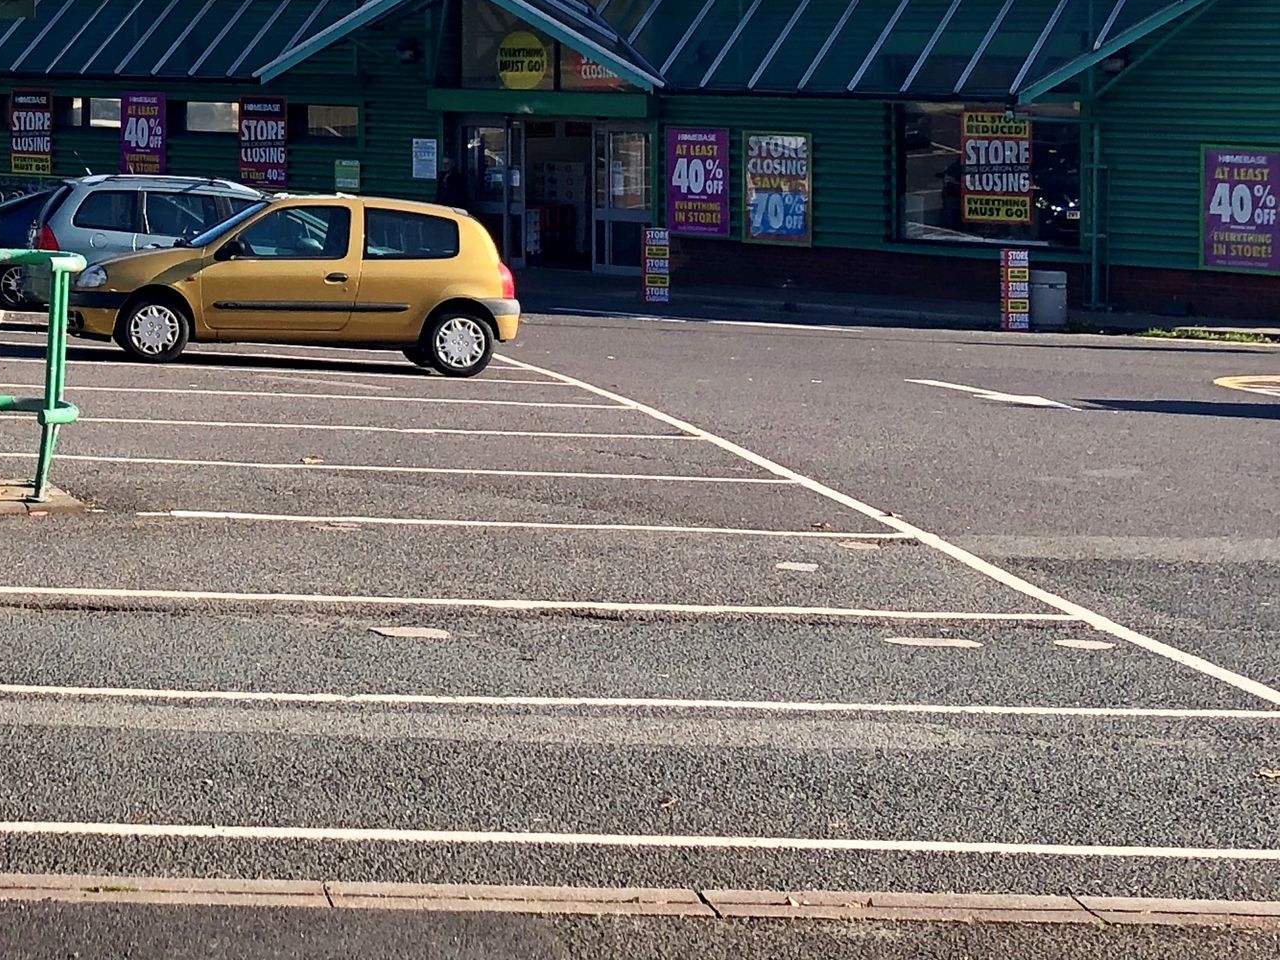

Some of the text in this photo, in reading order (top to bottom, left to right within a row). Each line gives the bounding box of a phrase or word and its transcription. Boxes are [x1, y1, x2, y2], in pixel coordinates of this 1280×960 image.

[499, 47, 544, 58] EVERYTHING
[499, 59, 544, 72] MUST GO!
[127, 105, 159, 116] AT LEAST
[12, 111, 51, 131] STORE
[967, 114, 986, 124] ALL
[124, 118, 162, 149] 40% OFF
[241, 119, 286, 141] STORE
[966, 125, 1027, 135] REDUCED!
[677, 133, 717, 142] HOMEBASE
[12, 136, 51, 152] CLOSING
[748, 136, 808, 158] STORE
[241, 147, 286, 164] CLOSING
[676, 144, 718, 157] AT LEAST
[965, 139, 1030, 165] STORE
[1218, 155, 1268, 164] HOMEBASE
[748, 157, 807, 176] CLOSING
[672, 158, 724, 195] 40% OFF
[1214, 168, 1270, 181] AT LEAST
[965, 173, 1030, 192] CLOSING
[675, 201, 721, 211] EVERYTHING
[967, 197, 1027, 208] EVERYTHING
[1209, 183, 1277, 225] 40% OFF
[675, 211, 685, 222] IN
[750, 192, 805, 230] 70% OFF
[967, 207, 1028, 218] MUST GO!
[646, 230, 669, 240] STORE
[1214, 231, 1272, 243] EVERYTHING
[1008, 251, 1028, 260] STORE
[1213, 243, 1272, 258] IN STORE!
[646, 259, 669, 268] STORE
[646, 287, 669, 296] STORE
[1008, 282, 1028, 291] STORE
[1008, 313, 1029, 322] STORE
